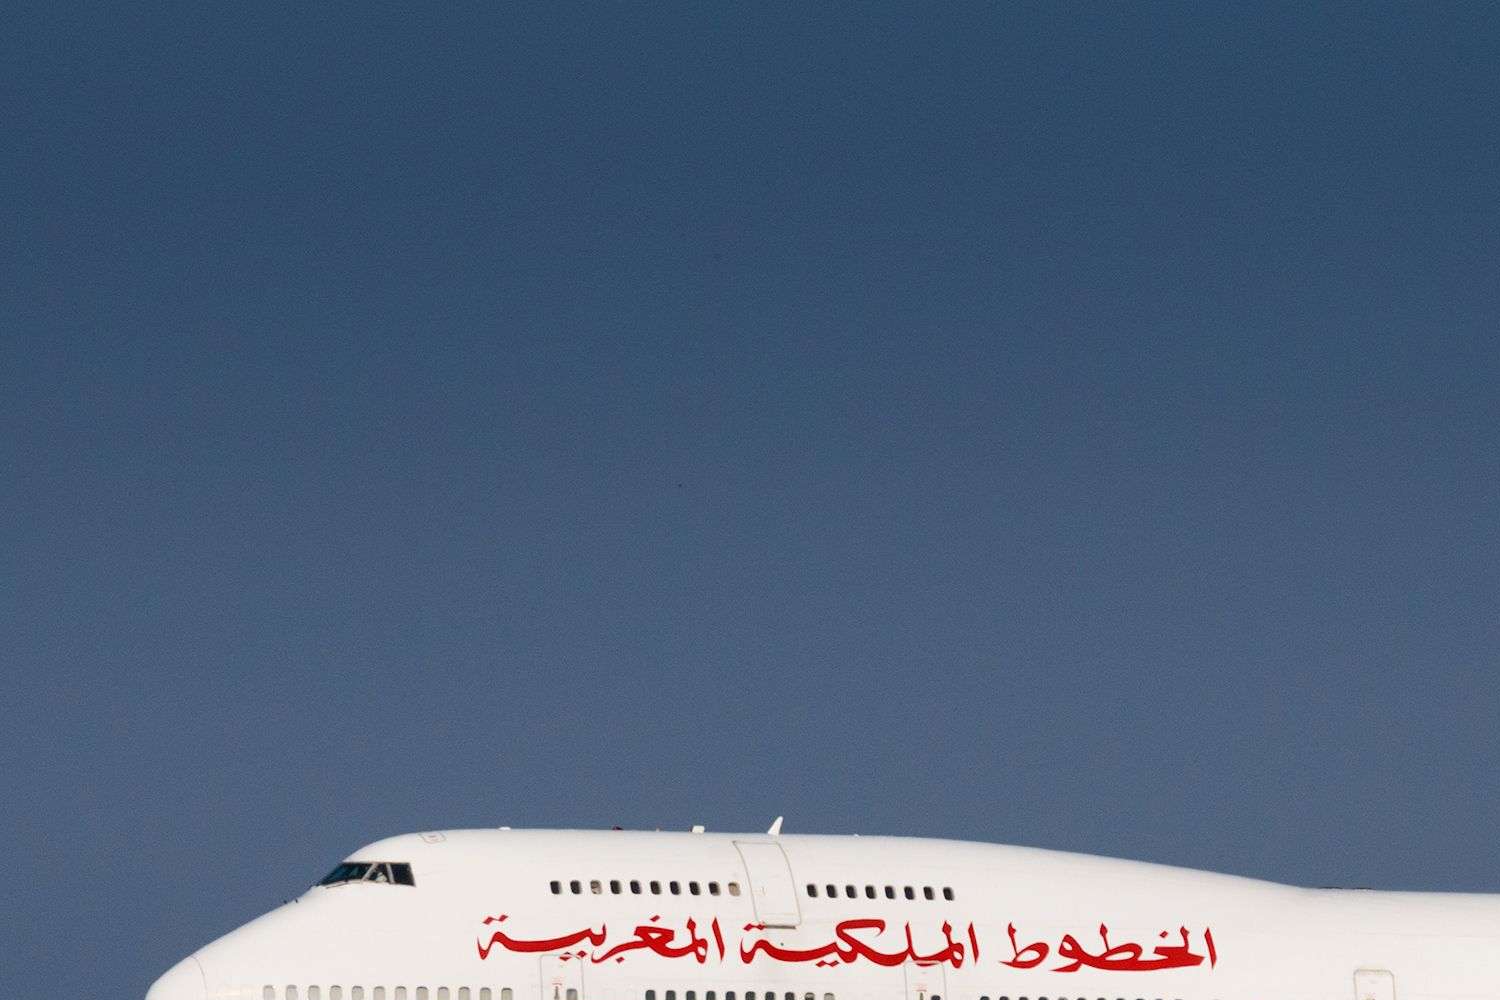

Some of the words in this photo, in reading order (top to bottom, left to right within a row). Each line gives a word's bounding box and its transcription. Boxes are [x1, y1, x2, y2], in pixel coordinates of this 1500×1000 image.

[477, 915, 725, 964] المغربية
[740, 918, 979, 969] الملكية
[1000, 922, 1217, 973] الخطوط
